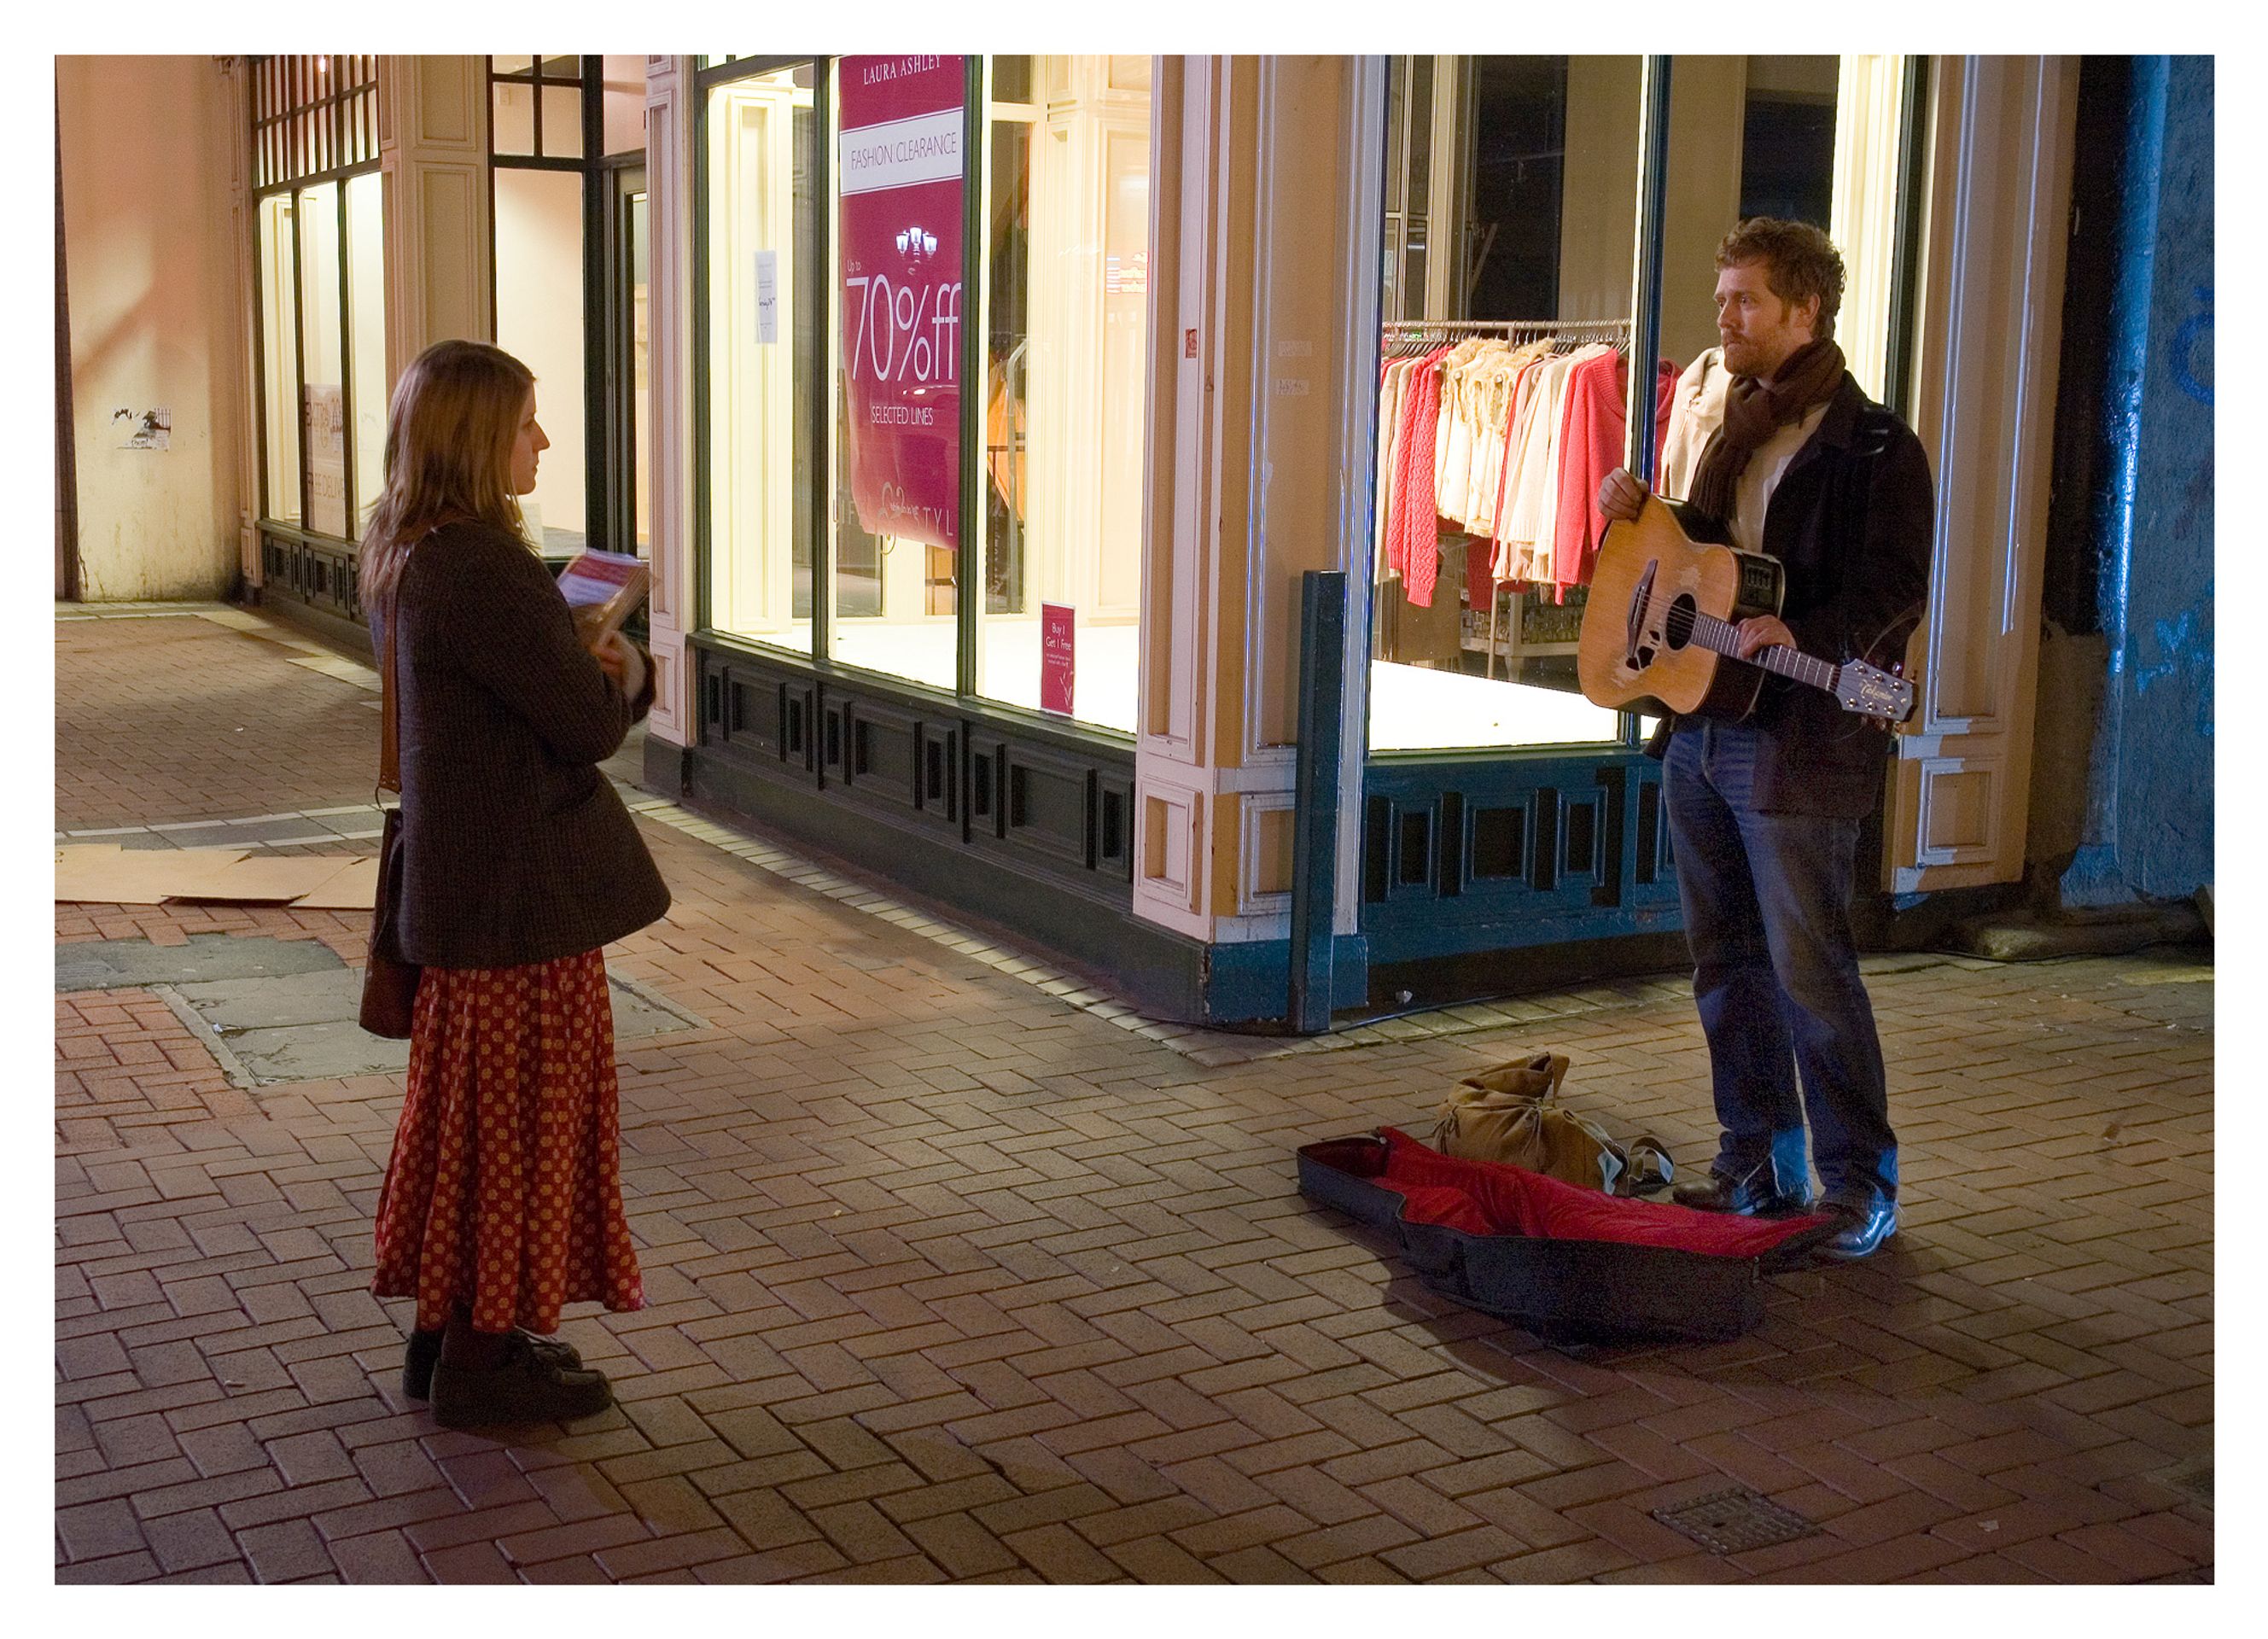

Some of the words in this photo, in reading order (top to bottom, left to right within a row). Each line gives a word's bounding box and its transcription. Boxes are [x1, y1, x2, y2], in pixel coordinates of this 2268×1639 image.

[864, 62, 896, 85] LAURA
[901, 55, 941, 76] ASHLEY
[851, 145, 893, 171] FASHION
[896, 131, 957, 162] CLEARANCE
[847, 259, 854, 273] Up
[872, 405, 908, 425] SELECTED
[910, 406, 934, 426] LINES
[1051, 621, 1062, 637] Buy
[1046, 636, 1056, 648] Get
